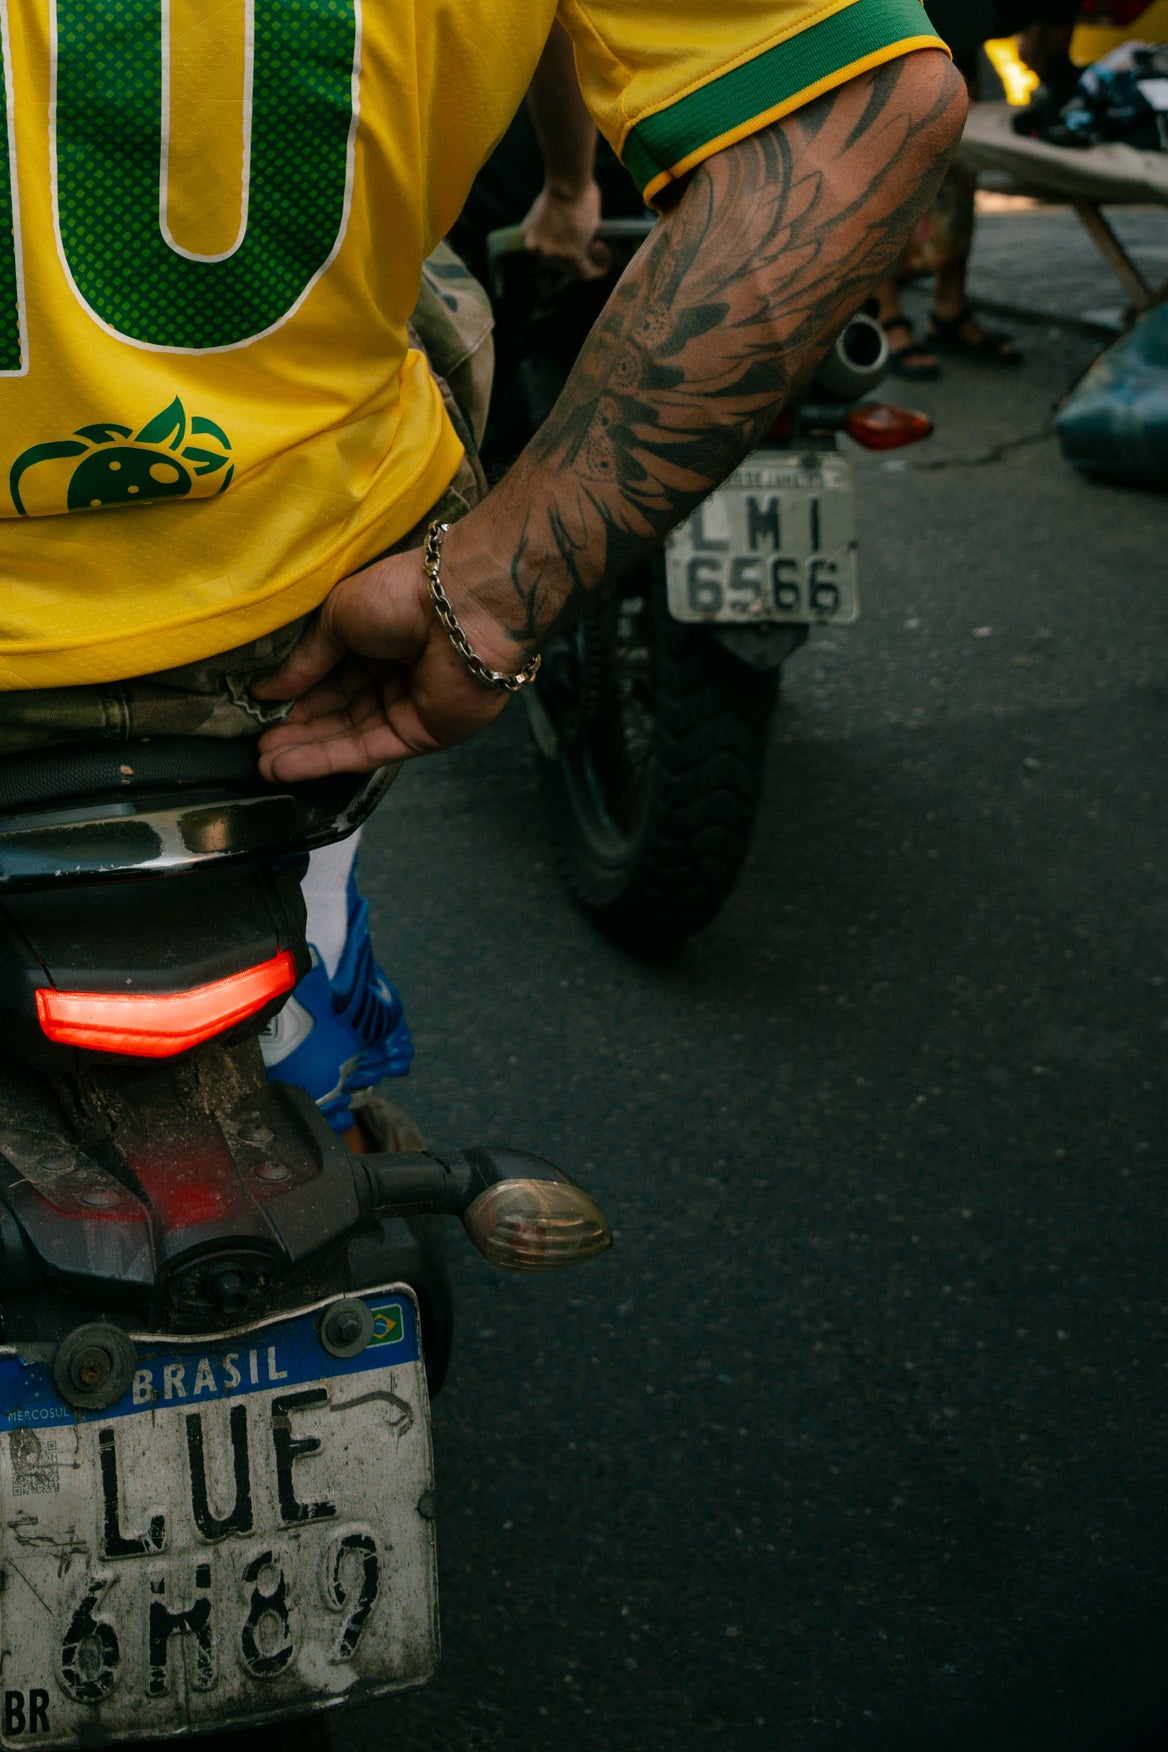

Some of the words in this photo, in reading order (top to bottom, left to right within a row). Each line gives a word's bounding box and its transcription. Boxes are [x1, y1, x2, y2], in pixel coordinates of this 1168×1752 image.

[687, 558, 840, 613] 6566
[132, 1346, 288, 1405] BRASIL
[8, 1407, 70, 1422] MERCOSUL
[98, 1388, 337, 1556] LUE
[62, 1532, 380, 1699] 6H89
[4, 1688, 51, 1736] BR
